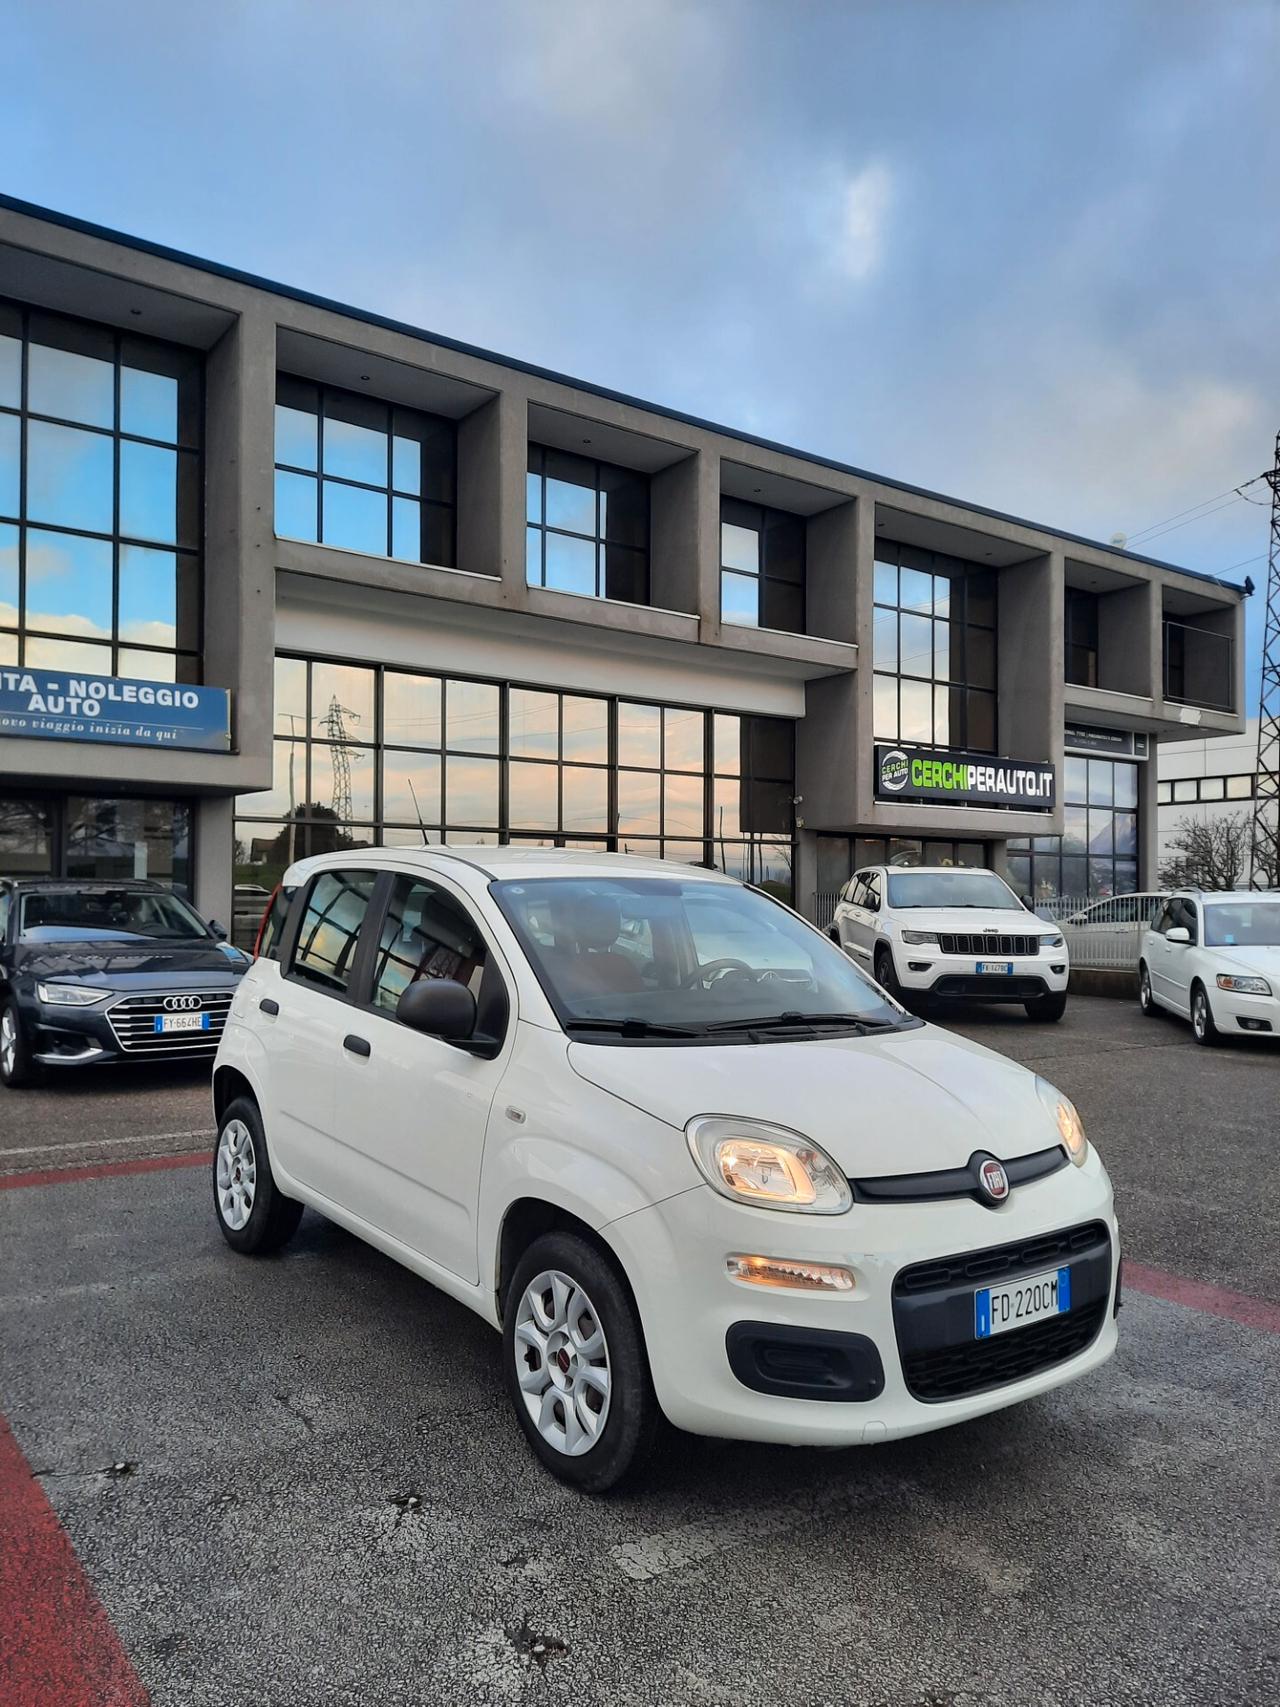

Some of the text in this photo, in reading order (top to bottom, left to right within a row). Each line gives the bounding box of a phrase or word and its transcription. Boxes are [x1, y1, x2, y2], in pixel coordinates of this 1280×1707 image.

[28, 694, 100, 717] AUTO
[69, 680, 199, 709] NOLEGGIO
[0, 718, 177, 741] ovo viaggio inizia da qui
[881, 759, 909, 774] CERCHI
[893, 767, 909, 778] AUTO
[911, 758, 1053, 797] CERCHIPERAUTO.IT
[986, 1170, 1005, 1189] FIAT
